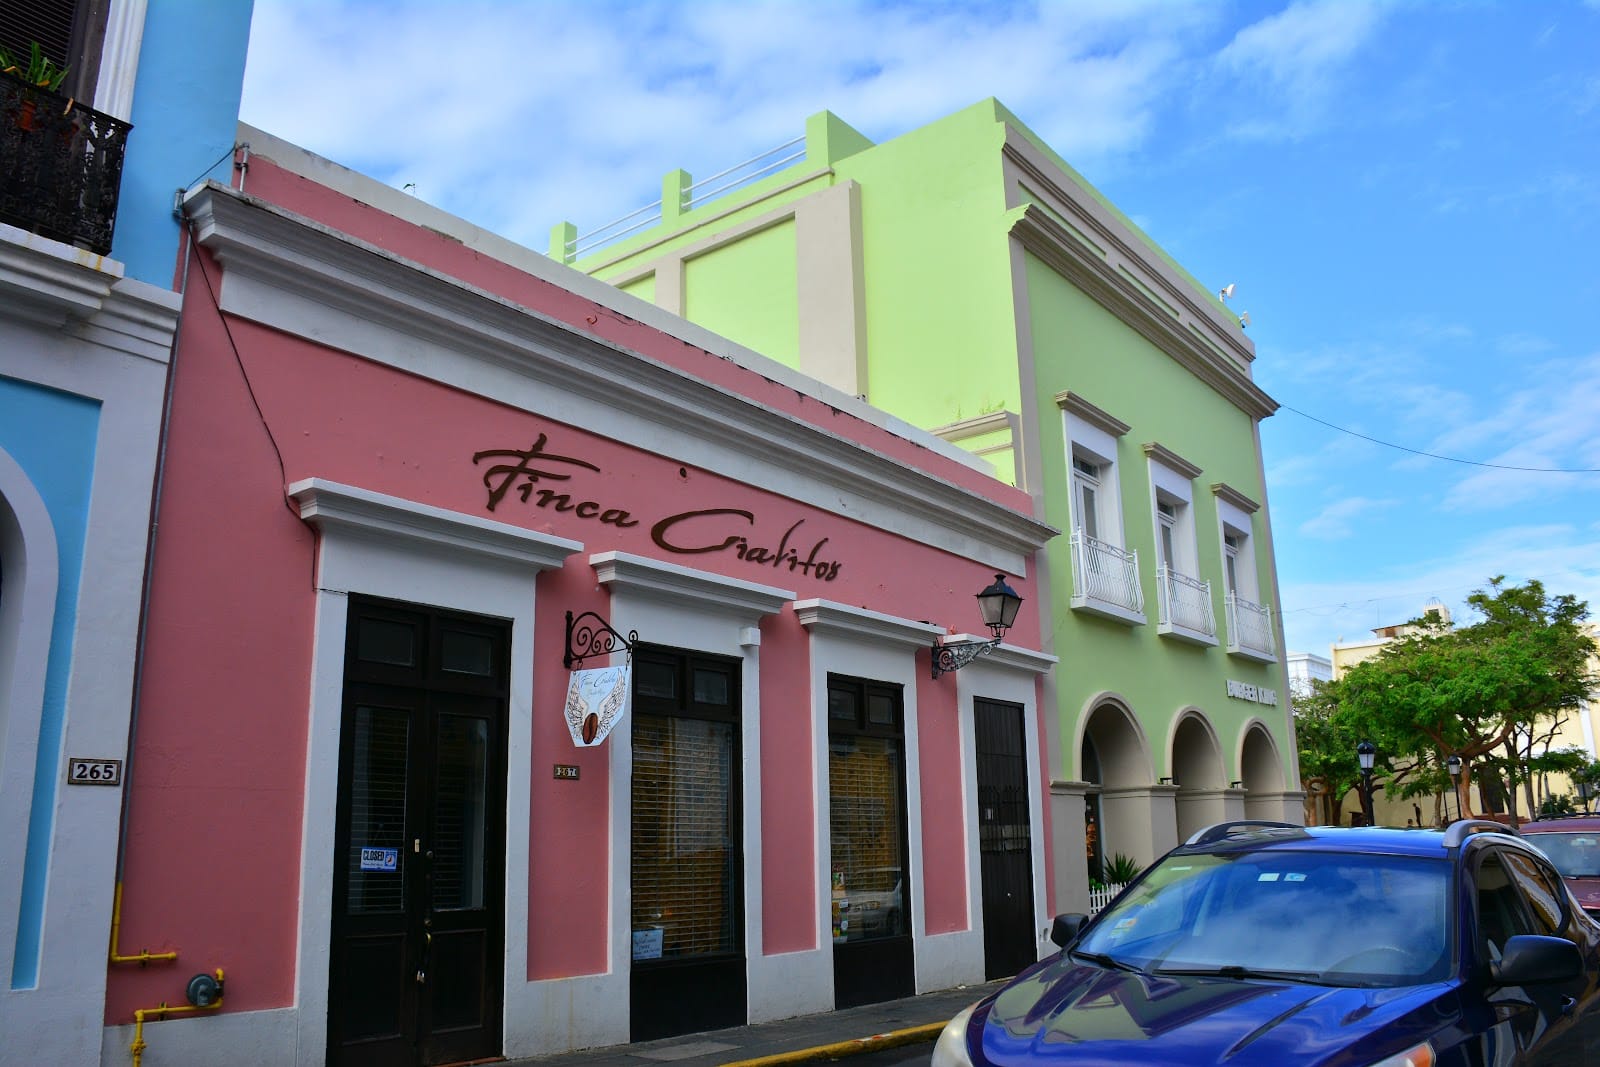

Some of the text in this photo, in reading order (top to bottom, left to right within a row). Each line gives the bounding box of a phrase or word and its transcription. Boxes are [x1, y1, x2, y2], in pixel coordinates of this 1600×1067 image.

[473, 433, 842, 582] Finca Cialitos
[76, 763, 114, 780] 265
[559, 767, 574, 777] 267
[362, 850, 385, 861] CLOSED
